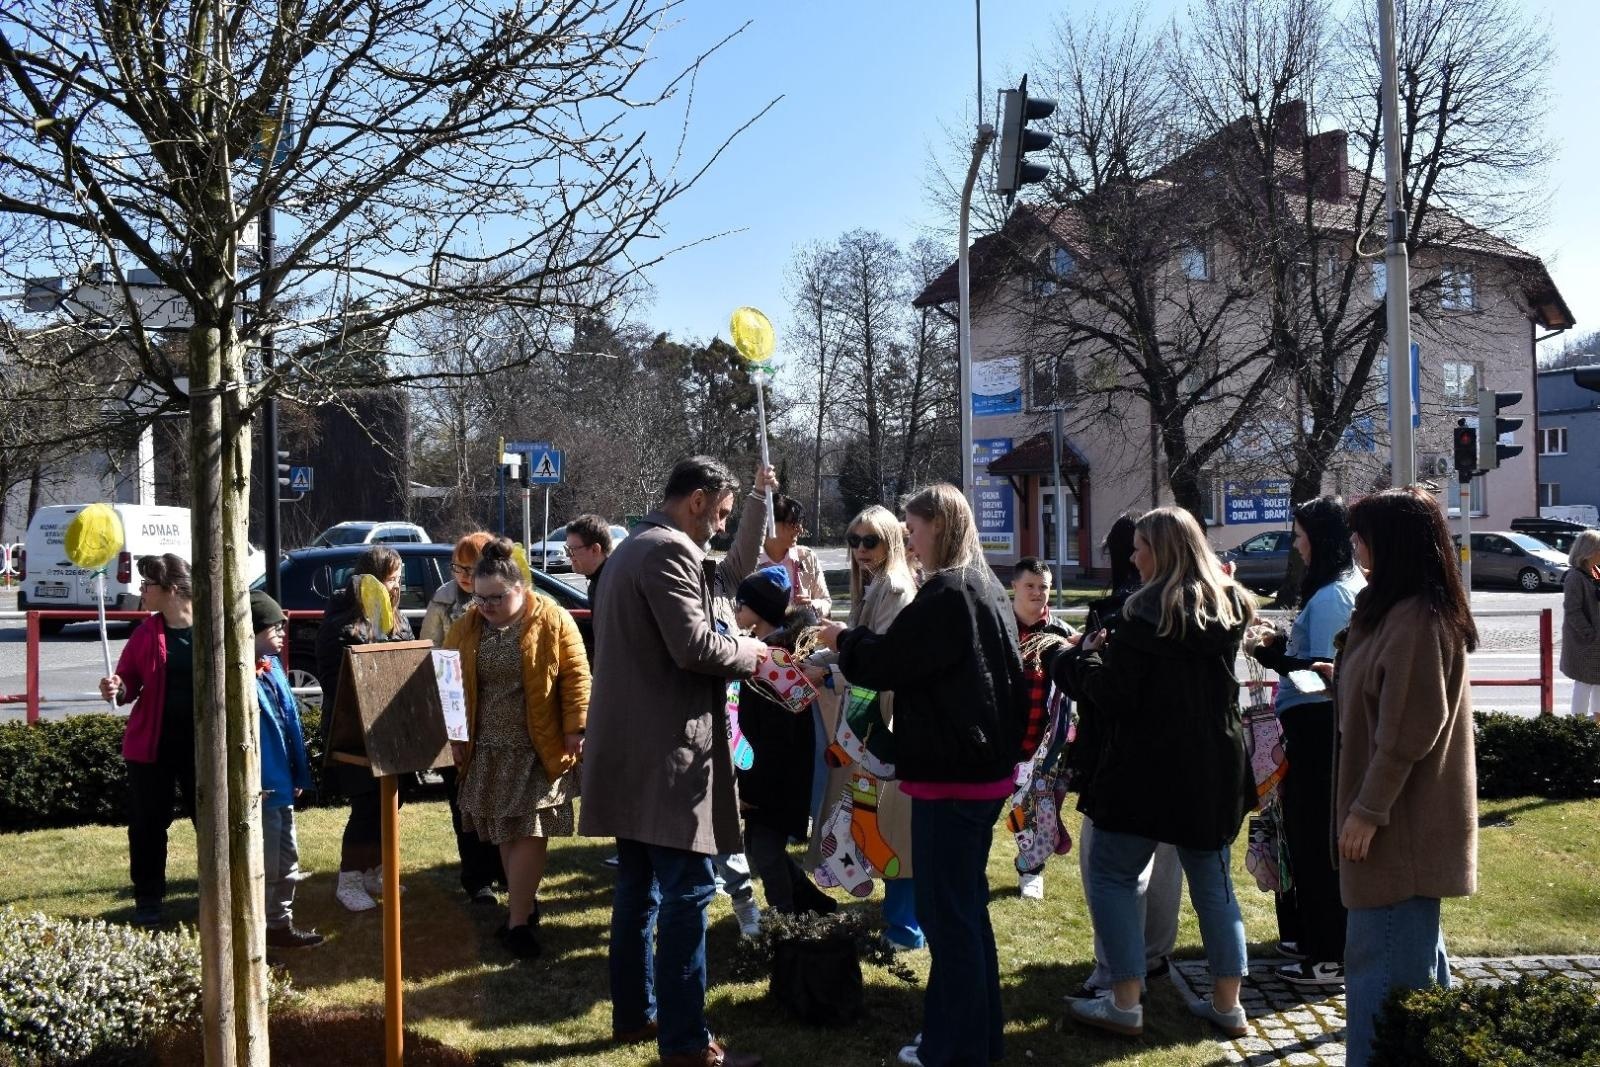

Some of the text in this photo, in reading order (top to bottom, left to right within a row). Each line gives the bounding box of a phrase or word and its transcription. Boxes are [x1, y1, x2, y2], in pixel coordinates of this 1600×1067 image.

[982, 491, 1000, 500] OKNA
[1232, 500, 1253, 508] OKNA
[982, 510, 1006, 519] ROLETY
[1232, 511, 1257, 520] DRZWI
[142, 524, 180, 536] ADMAR
